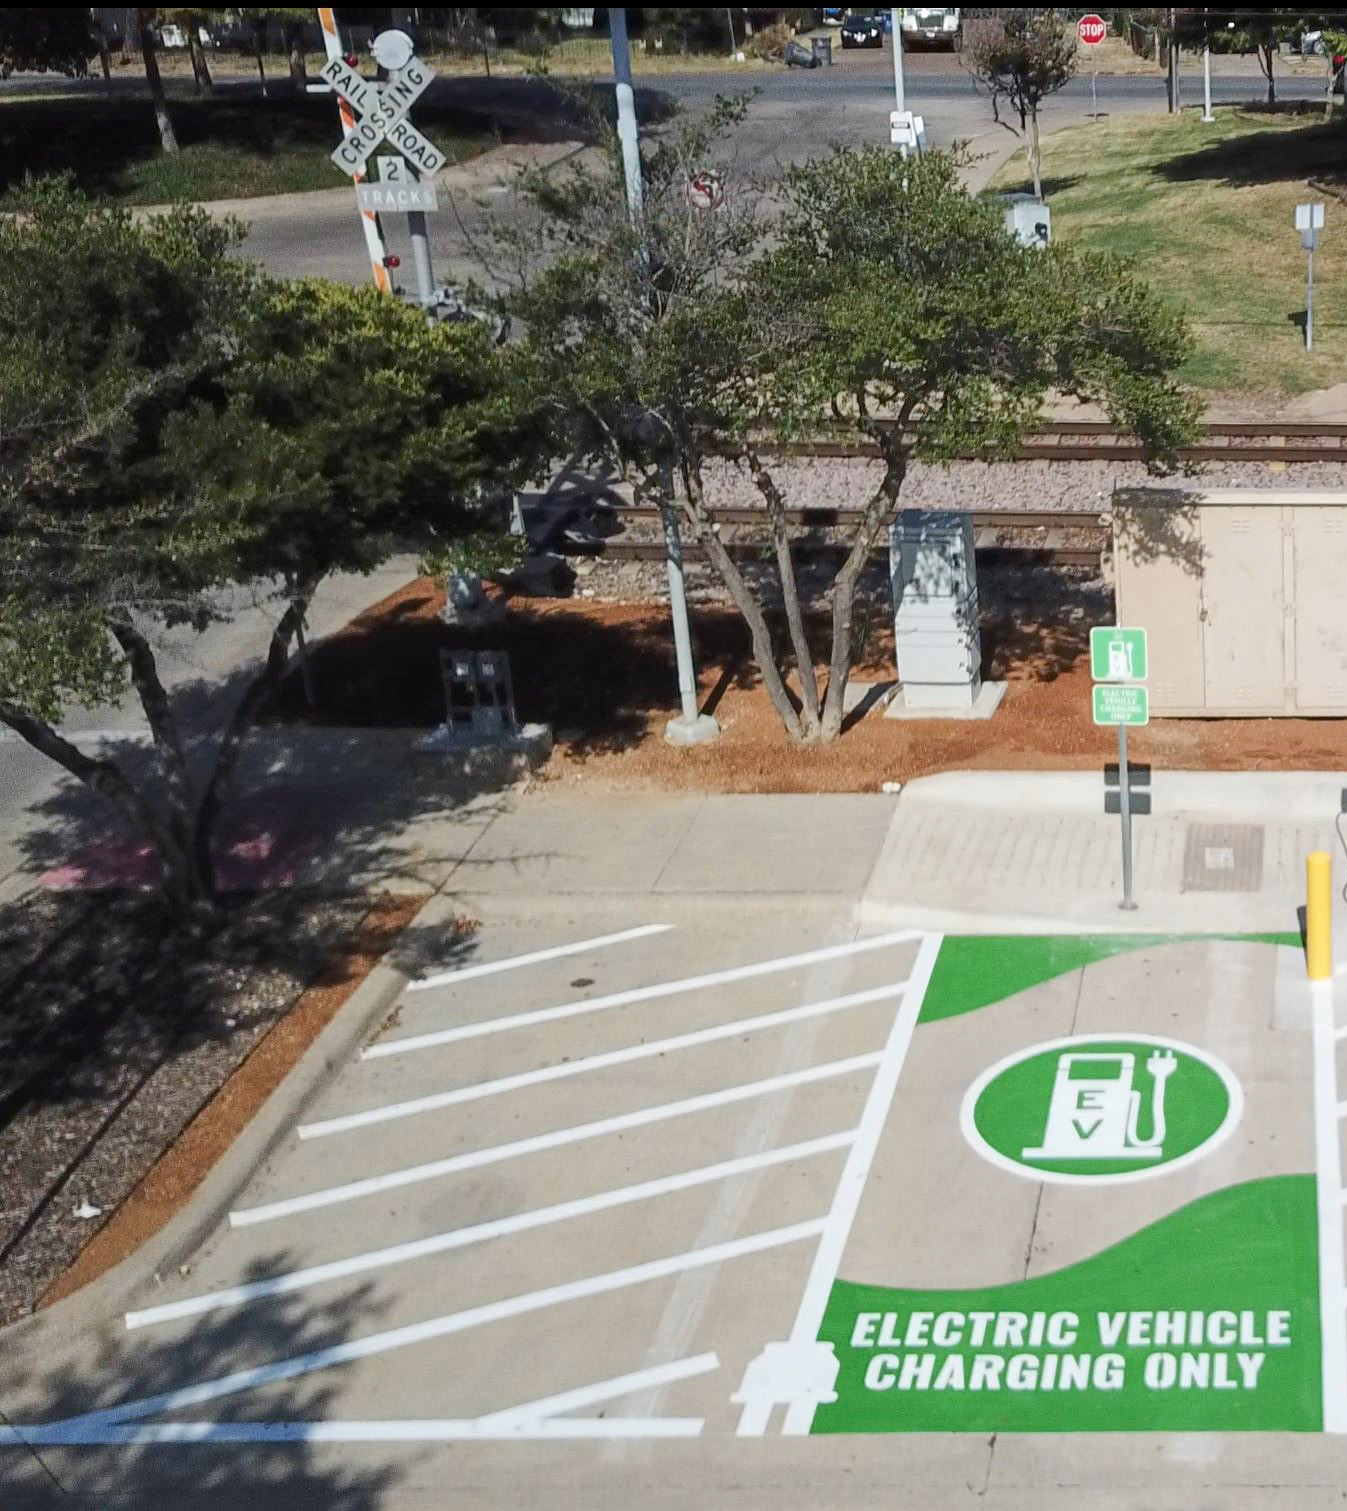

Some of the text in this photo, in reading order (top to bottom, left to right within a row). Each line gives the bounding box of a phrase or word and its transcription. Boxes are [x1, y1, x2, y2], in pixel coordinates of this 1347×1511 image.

[1079, 23, 1104, 37] STOP
[326, 61, 438, 170] RAIL ROAD
[341, 68, 424, 165] CROSSING
[386, 160, 400, 182] 2
[362, 189, 433, 206] TRACKS
[850, 1311, 1291, 1348] ELECTRIC VEHICLE
[864, 1353, 1265, 1391] CHARGING ONLY
